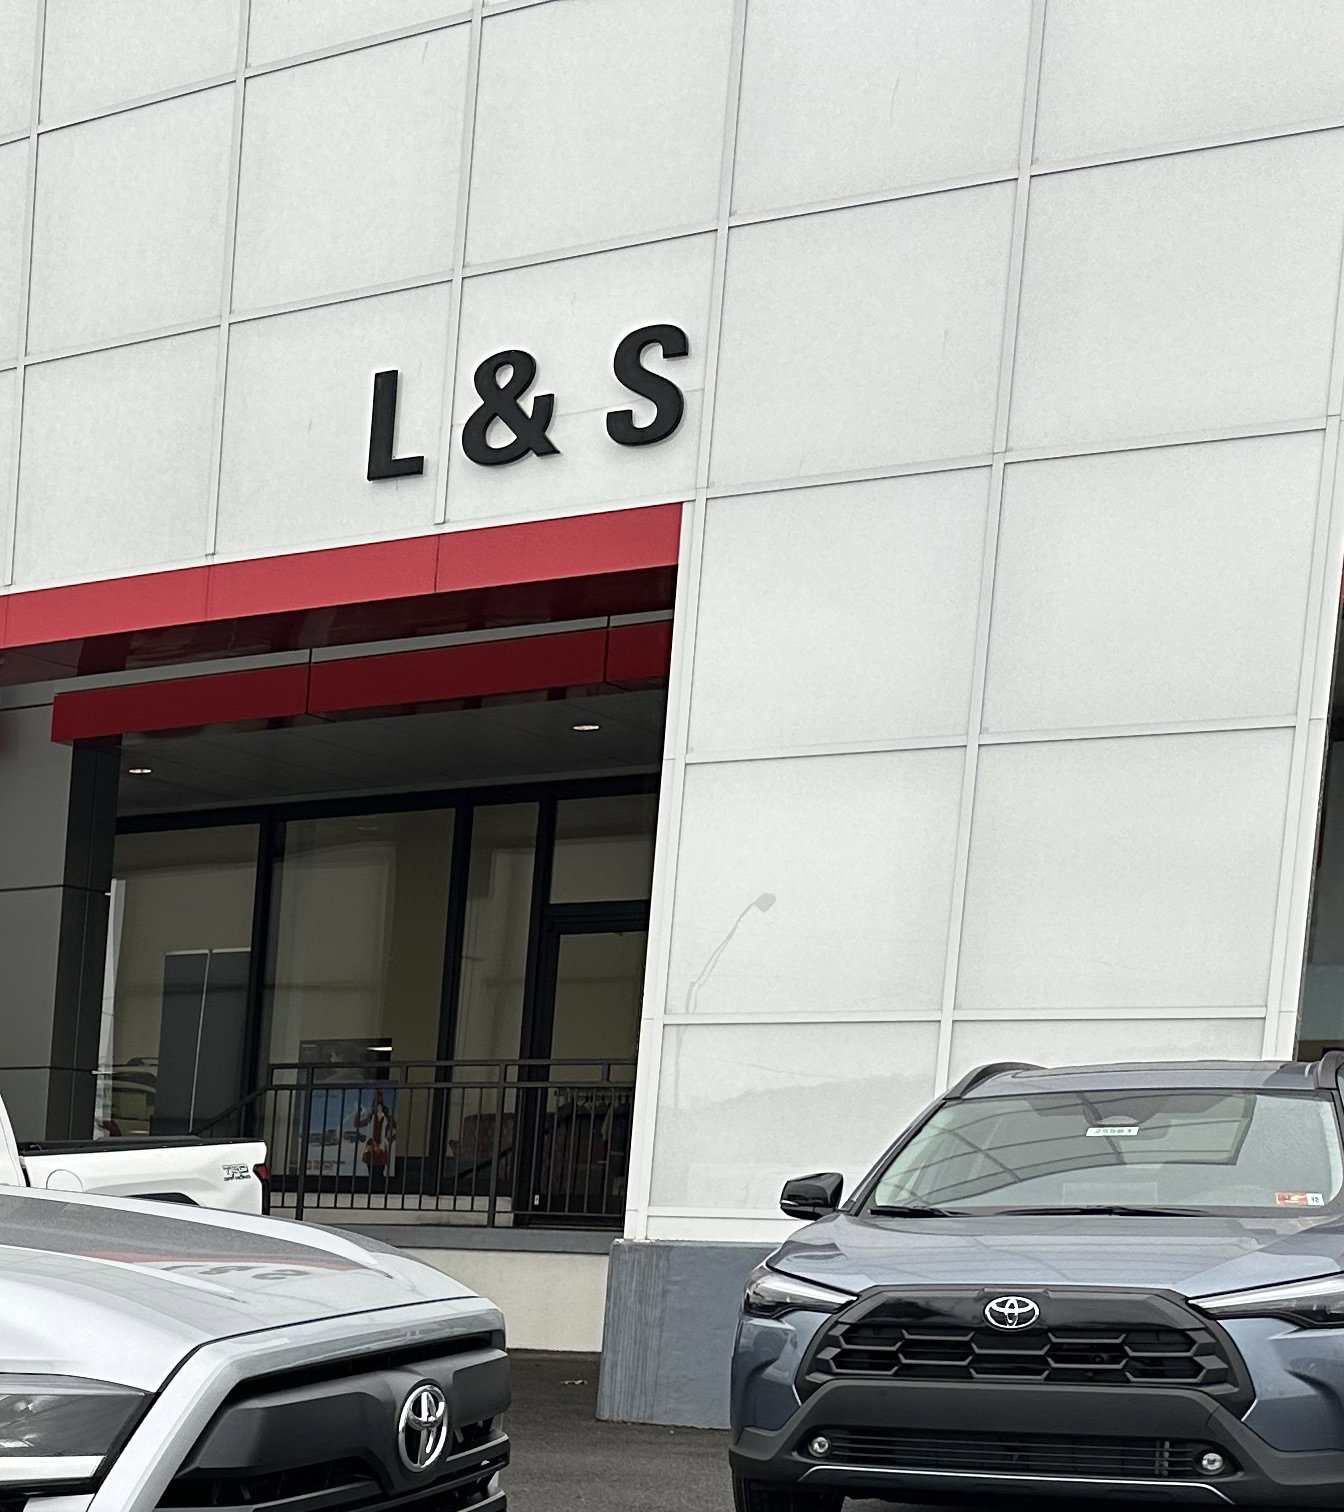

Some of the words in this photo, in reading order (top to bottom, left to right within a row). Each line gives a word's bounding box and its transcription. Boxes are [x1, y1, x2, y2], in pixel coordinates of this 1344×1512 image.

[367, 369, 424, 481] L
[462, 349, 560, 466] &
[607, 323, 689, 447] S
